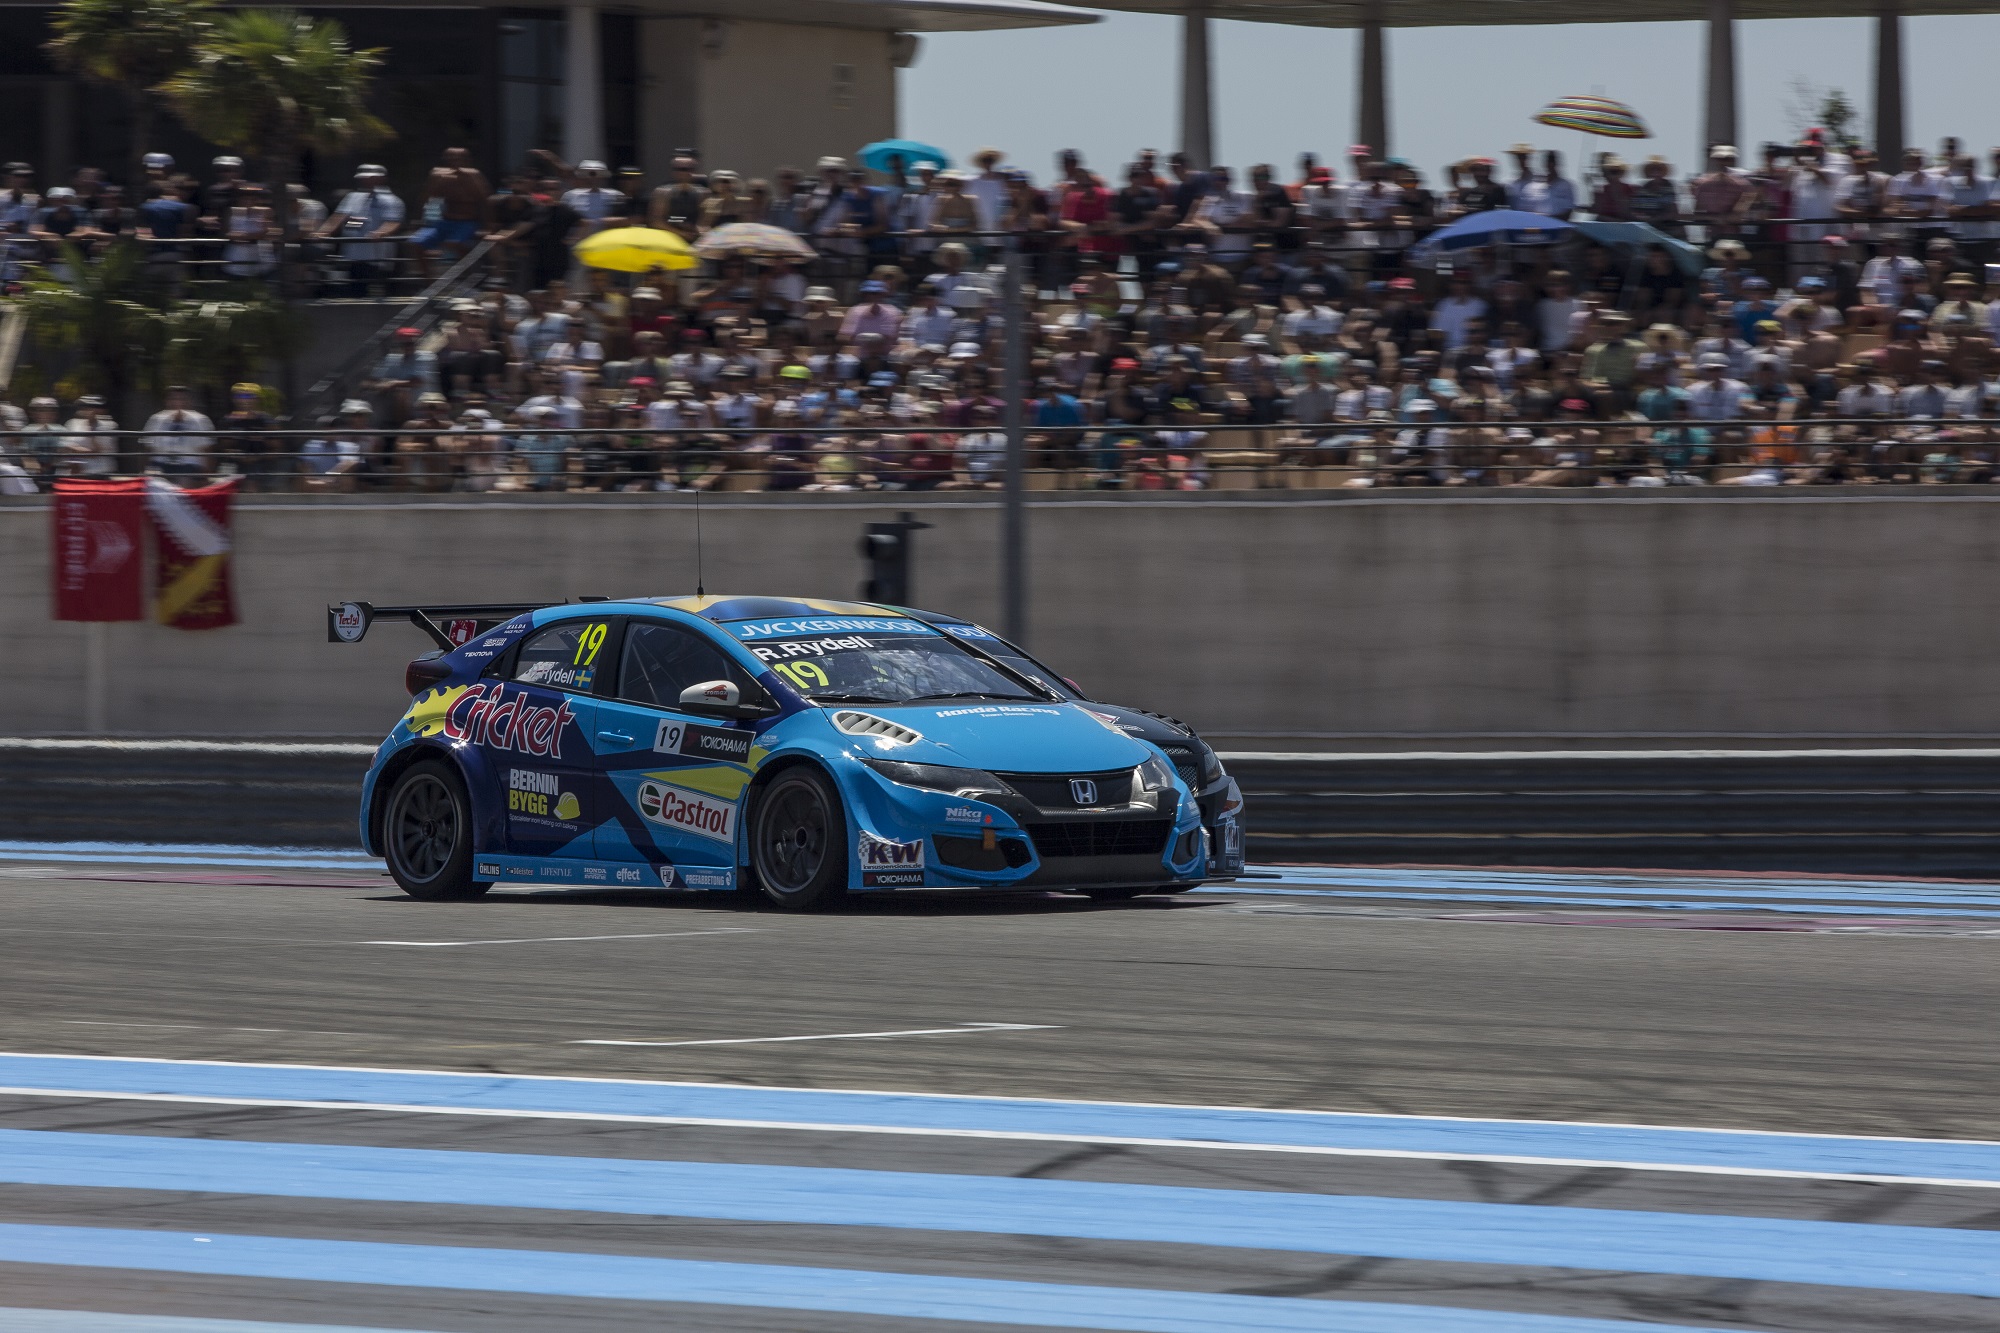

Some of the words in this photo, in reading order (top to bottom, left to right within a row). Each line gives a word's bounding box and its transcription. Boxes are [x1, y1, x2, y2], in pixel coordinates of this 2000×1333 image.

[741, 620, 928, 637] JVCKENWOOD
[573, 623, 608, 665] 19
[773, 661, 830, 689] 19
[443, 682, 577, 759] Cricket
[936, 706, 997, 718] Honda
[997, 706, 1061, 717] Racing
[659, 725, 681, 748] 19
[700, 735, 748, 754] YOKOHAMA
[510, 768, 559, 796] BERNIN
[509, 789, 548, 815] BYGG
[945, 807, 982, 818] Nika
[662, 791, 729, 835] Castrol
[867, 841, 923, 864] KW
[479, 863, 500, 875] ÖHLINS
[540, 867, 573, 877] LIFESTYLE
[616, 867, 640, 882] effect
[876, 875, 923, 884] YOKOHAMA
